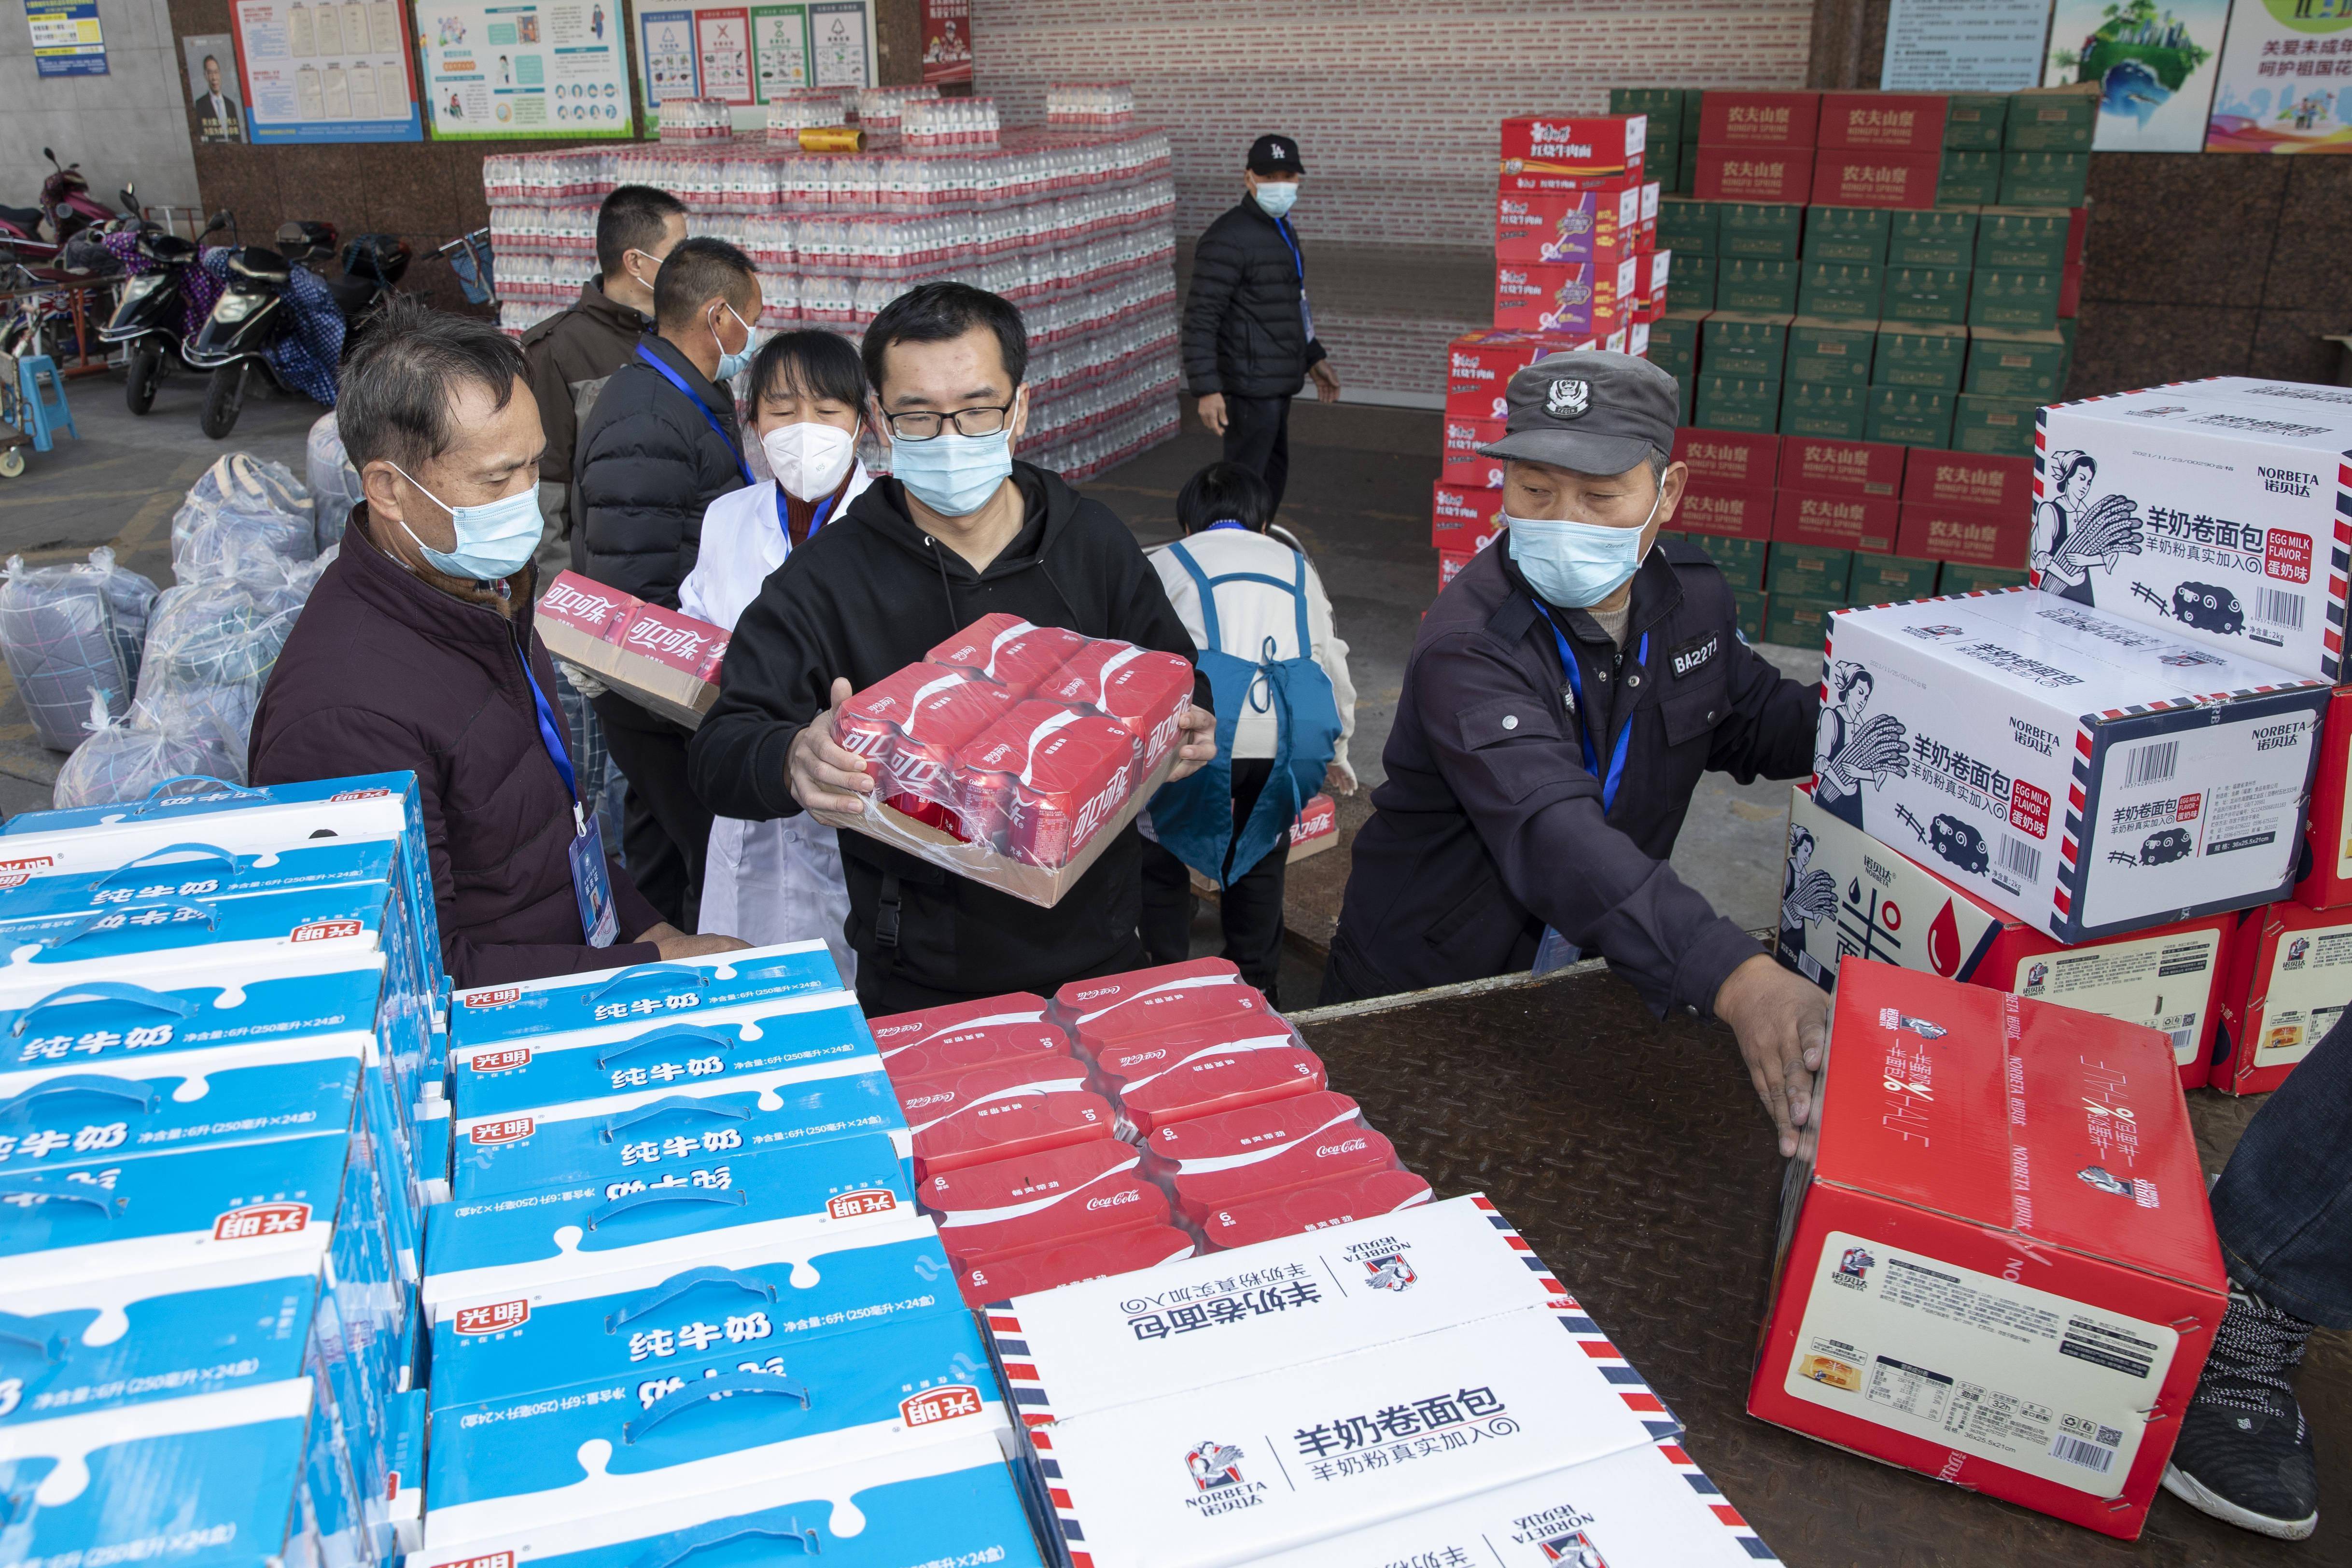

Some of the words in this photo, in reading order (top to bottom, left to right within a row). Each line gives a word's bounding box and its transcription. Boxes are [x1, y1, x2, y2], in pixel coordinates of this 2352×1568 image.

[2257, 60, 2352, 77] 呵护祖国花
[1728, 107, 1790, 123] 农夫山泉
[1848, 109, 1915, 126] 农夫山泉
[1271, 144, 1285, 159] LA
[1723, 161, 1784, 178] 农夫山泉
[1843, 165, 1907, 183] 农夫山泉
[1687, 443, 1750, 462] 农夫山泉
[1804, 446, 1870, 466] 农夫山泉
[1936, 466, 2004, 487] 农夫山泉
[2257, 466, 2319, 486] NORBETA
[2264, 479, 2310, 498] 诺贝达
[1682, 495, 1745, 516] 农夫山泉
[1800, 500, 1866, 521] 农夫山泉
[1930, 520, 1998, 542] 农夫山泉
[2146, 505, 2264, 554] 羊奶卷面包
[2269, 532, 2287, 546] EGG
[2288, 536, 2310, 550] MILK
[2146, 536, 2245, 572] 羊奶粉真实加入
[2268, 545, 2302, 560] FLAVOR
[2267, 560, 2308, 581] 蛋奶味
[543, 583, 619, 625] 可口可乐
[628, 617, 712, 660] 可口可乐
[951, 646, 977, 661] Coca-Cola
[1675, 637, 1717, 673] BA2271
[1973, 643, 2085, 685] 羊奶卷面包
[1060, 678, 1086, 698] Coca-Cola
[867, 697, 896, 714] Coca-Cola
[2009, 716, 2060, 747] NORBETA
[2252, 722, 2306, 740] NORBETA
[2014, 730, 2052, 757] 诺贝达
[2257, 734, 2297, 752] 诺贝达
[982, 743, 1012, 765] Coca-Cola
[1912, 733, 2011, 802] 羊奶卷面包
[1072, 751, 1134, 848] 可口可乐
[1911, 762, 1993, 817] 羊奶粉真实加入
[2016, 784, 2030, 798] EGG
[2030, 791, 2049, 807] MILK
[2014, 796, 2041, 816] FLAVOR
[2112, 798, 2177, 825] 羊奶卷面包
[2011, 810, 2046, 837] 蛋奶味
[2111, 817, 2166, 835] 羊奶粉真实加入
[1864, 854, 1892, 883] 诺贝达
[1865, 867, 1889, 888] NORBETA
[90, 879, 220, 905] 纯牛奶
[294, 922, 360, 941] 光明
[470, 990, 519, 1004] 光明
[1076, 985, 1120, 1000] Coca-Cola
[1144, 994, 1184, 1005] 畅爽带劲
[2023, 986, 2045, 994] 诺贝达
[594, 992, 701, 1021] 纯牛奶
[876, 1022, 923, 1038] Coca-Cola
[1886, 1008, 1899, 1031] 诺贝达
[19, 1024, 175, 1061] 纯牛奶
[943, 1033, 985, 1044] 畅爽带劲
[476, 1050, 529, 1067] 光明
[1119, 1049, 1166, 1067] Coca-Cola
[1193, 1060, 1235, 1072] 畅爽带劲
[611, 1056, 726, 1089] 纯牛奶
[2009, 1055, 2024, 1094] NORBETA
[2080, 1055, 2131, 1108] HALF
[906, 1092, 955, 1109] Coca-Cola
[978, 1103, 1022, 1116] 畅爽带劲
[1085, 1113, 1096, 1121] 6
[1883, 1090, 1930, 1148] HALF
[2013, 1098, 2026, 1126] 诺贝达
[476, 1119, 530, 1137] 光明
[1163, 1128, 1174, 1136] 6
[1240, 1131, 1286, 1145] 畅爽带劲
[621, 1129, 743, 1166] 纯牛奶
[1316, 1137, 1367, 1157] Coca-Cola
[2013, 1145, 2030, 1191] NORBETA
[1011, 1181, 1059, 1196] 畅爽带劲
[833, 1191, 896, 1218] 光明
[1086, 1189, 1140, 1210] Coca-Cola
[219, 1208, 308, 1239] 光明
[1304, 1215, 1353, 1232] 畅爽带劲
[1343, 1242, 1411, 1262] NORBETA
[1345, 1235, 1397, 1252] 诺贝达
[1151, 1263, 1306, 1306] 羊奶粉真实加入
[1832, 1272, 1869, 1289] 诺贝达
[1833, 1279, 1865, 1292] NORBETA
[460, 1302, 524, 1329] 光明
[1128, 1281, 1322, 1340] 羊奶卷面包
[630, 1312, 772, 1363] 纯牛奶
[903, 1391, 979, 1426] 光明
[1992, 1400, 2011, 1411] 32h
[1294, 1386, 1505, 1457] 羊奶卷面包
[1964, 1432, 2016, 1453] 36x25.5x21cm
[1311, 1425, 1495, 1482] 羊奶粉真实加入
[1186, 1481, 1267, 1508] NORBETA
[1201, 1494, 1264, 1517] 诺贝达
[1512, 1512, 1595, 1543] NORBETA
[1513, 1505, 1577, 1529] 诺贝达
